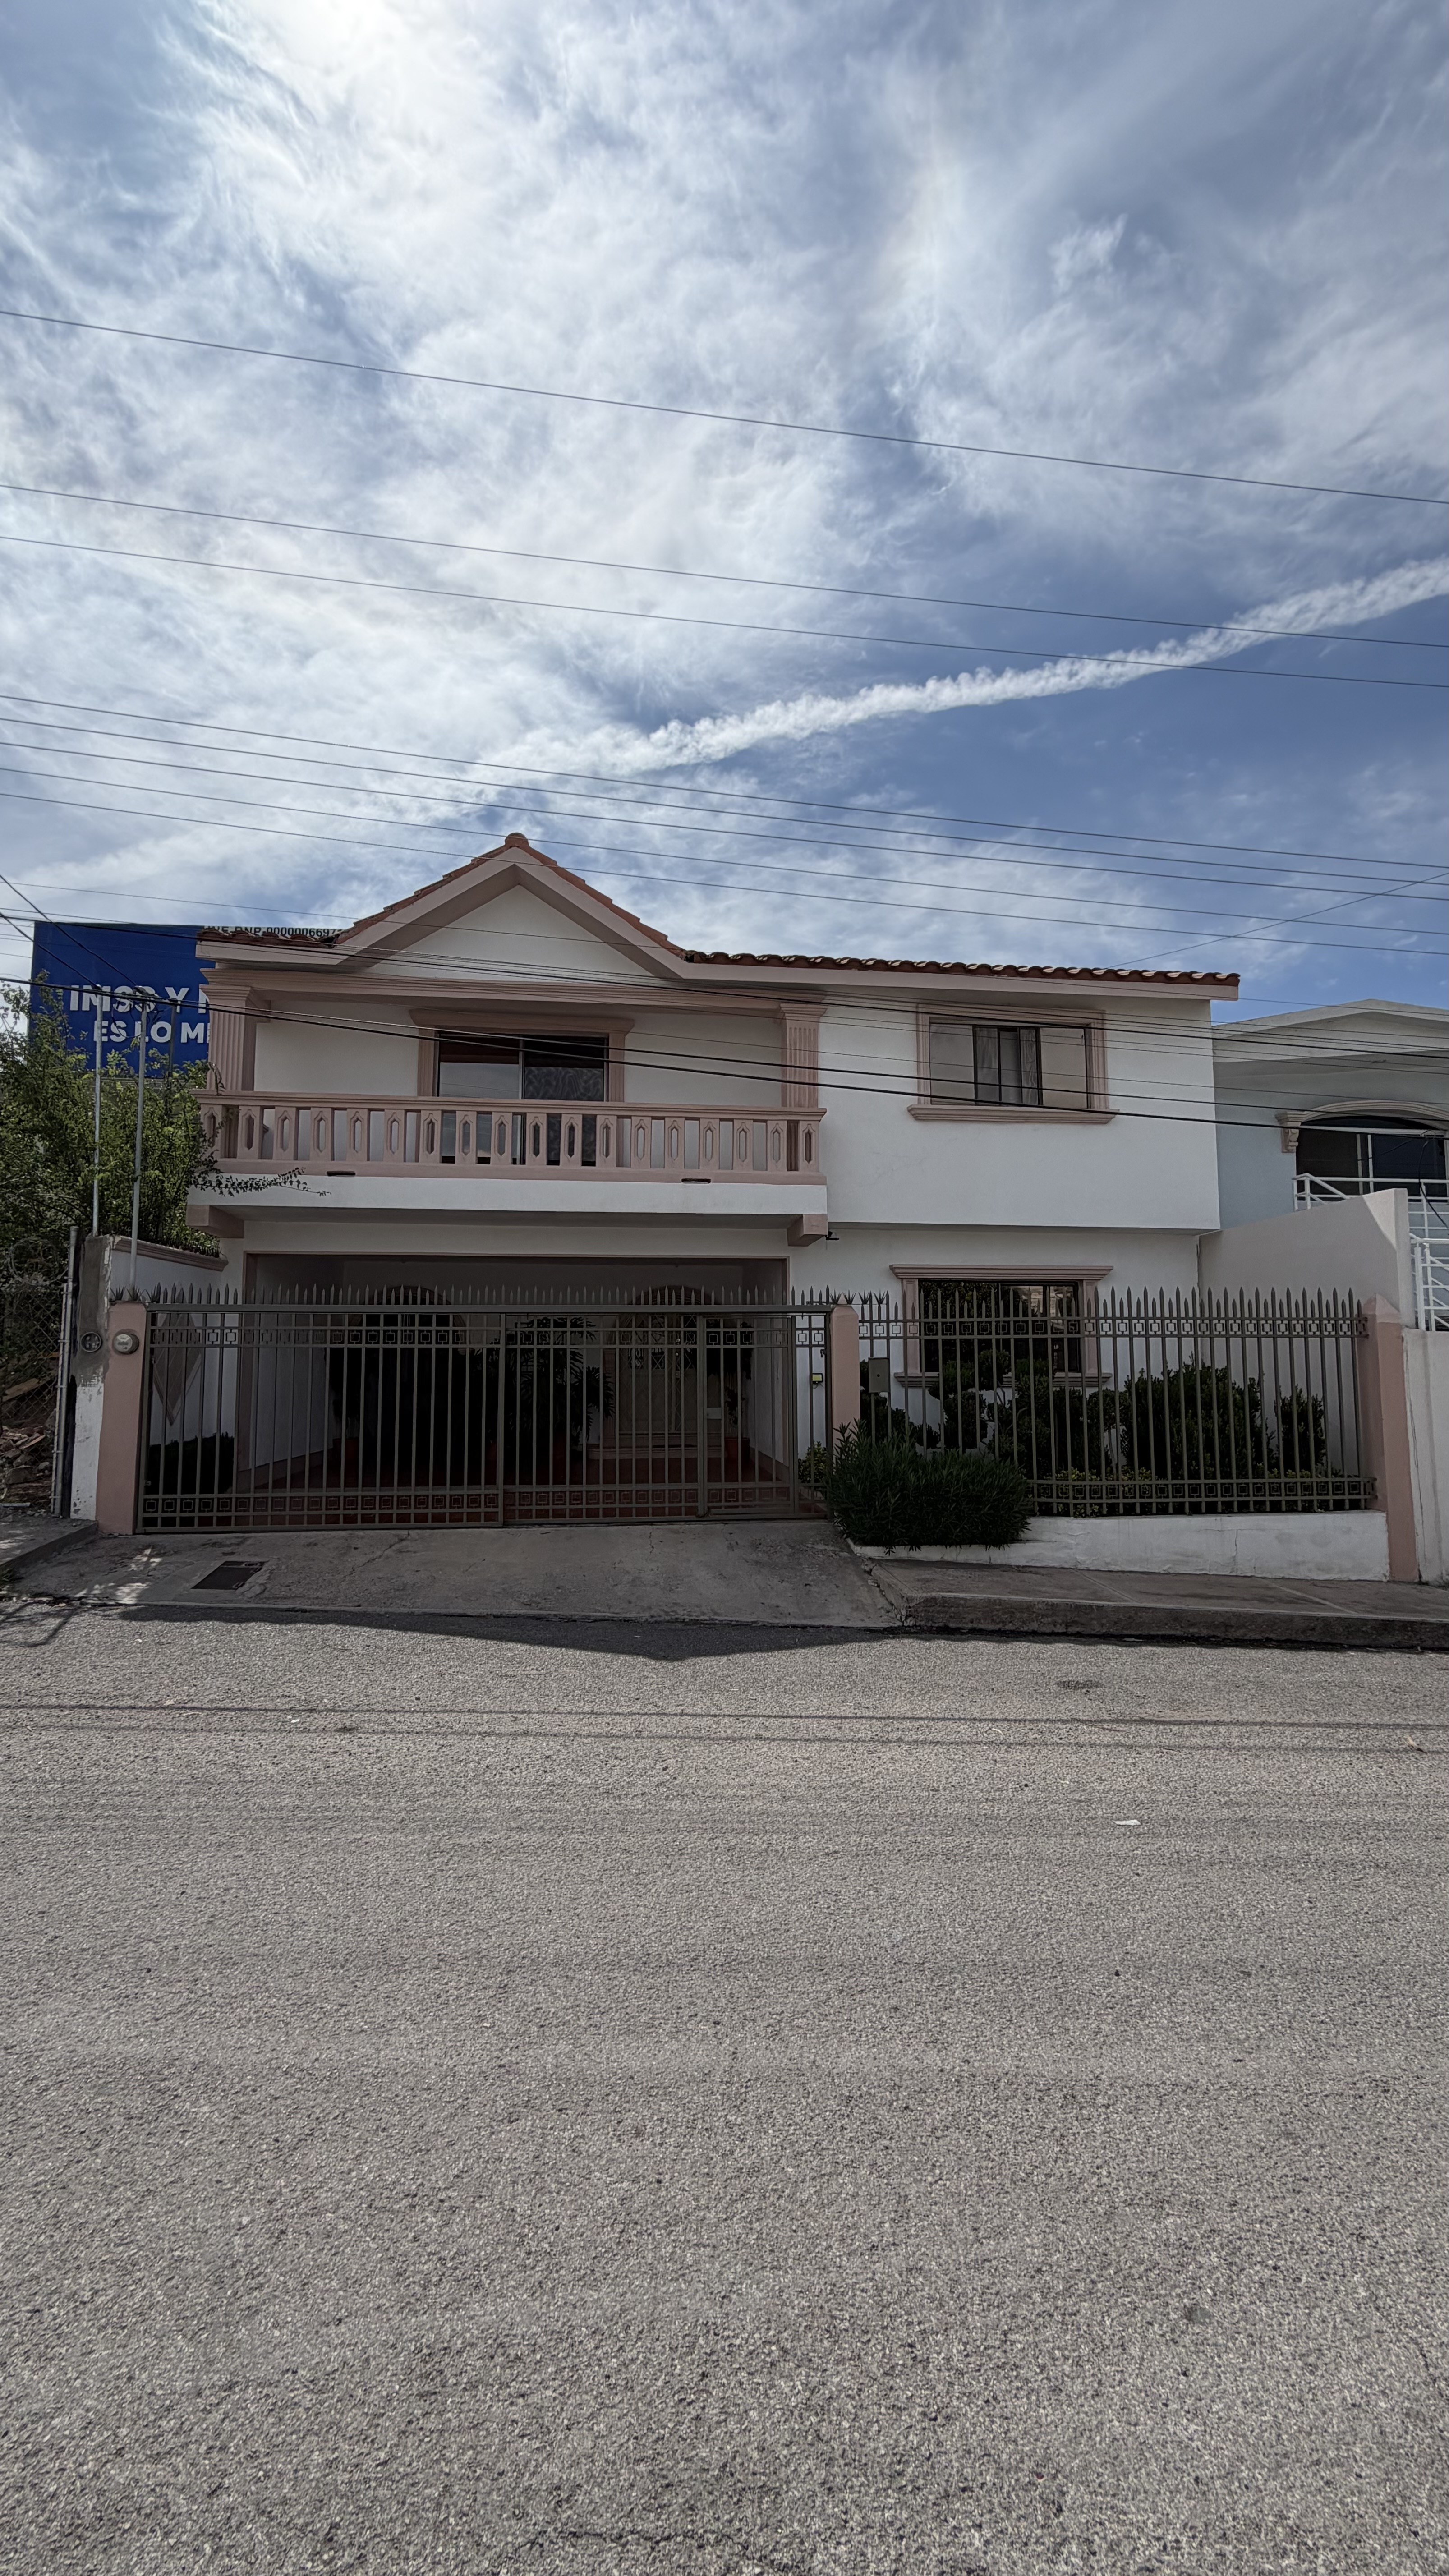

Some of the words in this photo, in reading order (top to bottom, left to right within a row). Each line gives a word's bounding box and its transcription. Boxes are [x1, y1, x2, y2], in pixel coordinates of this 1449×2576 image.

[70, 985, 156, 1012] IMSS
[165, 987, 189, 1013] Y
[93, 1021, 127, 1042] ES
[134, 1021, 174, 1043] LO
[180, 1022, 210, 1043] M
